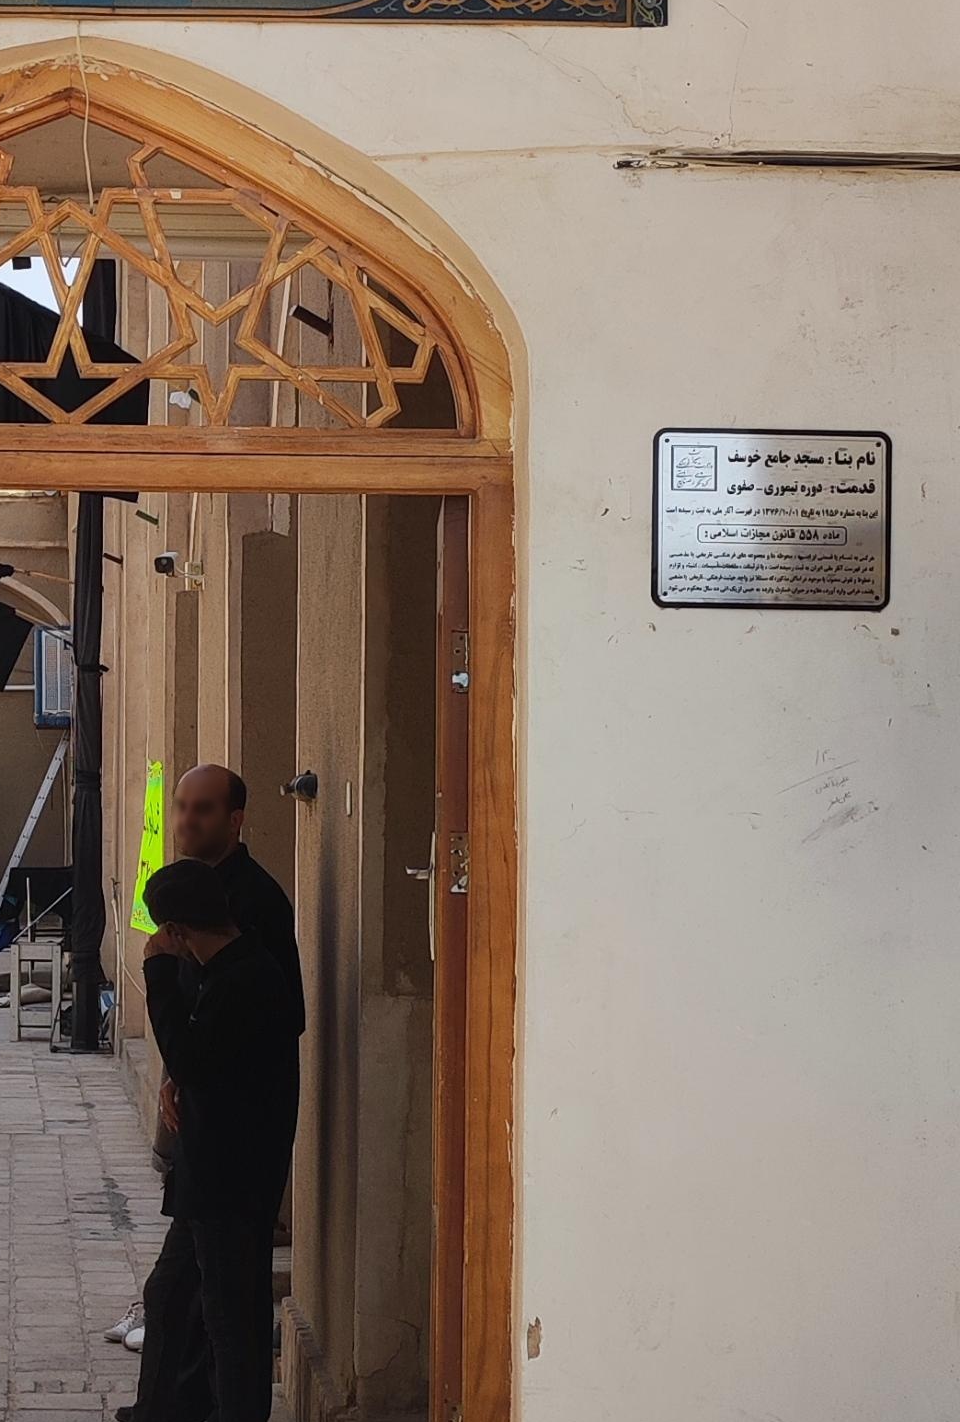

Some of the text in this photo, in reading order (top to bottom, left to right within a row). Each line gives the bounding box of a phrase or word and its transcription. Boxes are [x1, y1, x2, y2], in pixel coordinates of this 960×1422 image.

[728, 449, 761, 467] خوسف
[764, 450, 791, 467] جامع
[794, 451, 824, 468] مسجد
[857, 451, 876, 470] نام
[801, 483, 823, 497] دوره
[740, 528, 770, 540] مجازات
[772, 529, 795, 541] قانون
[799, 529, 819, 540] ۵۵۸
[823, 530, 840, 540] ماده
